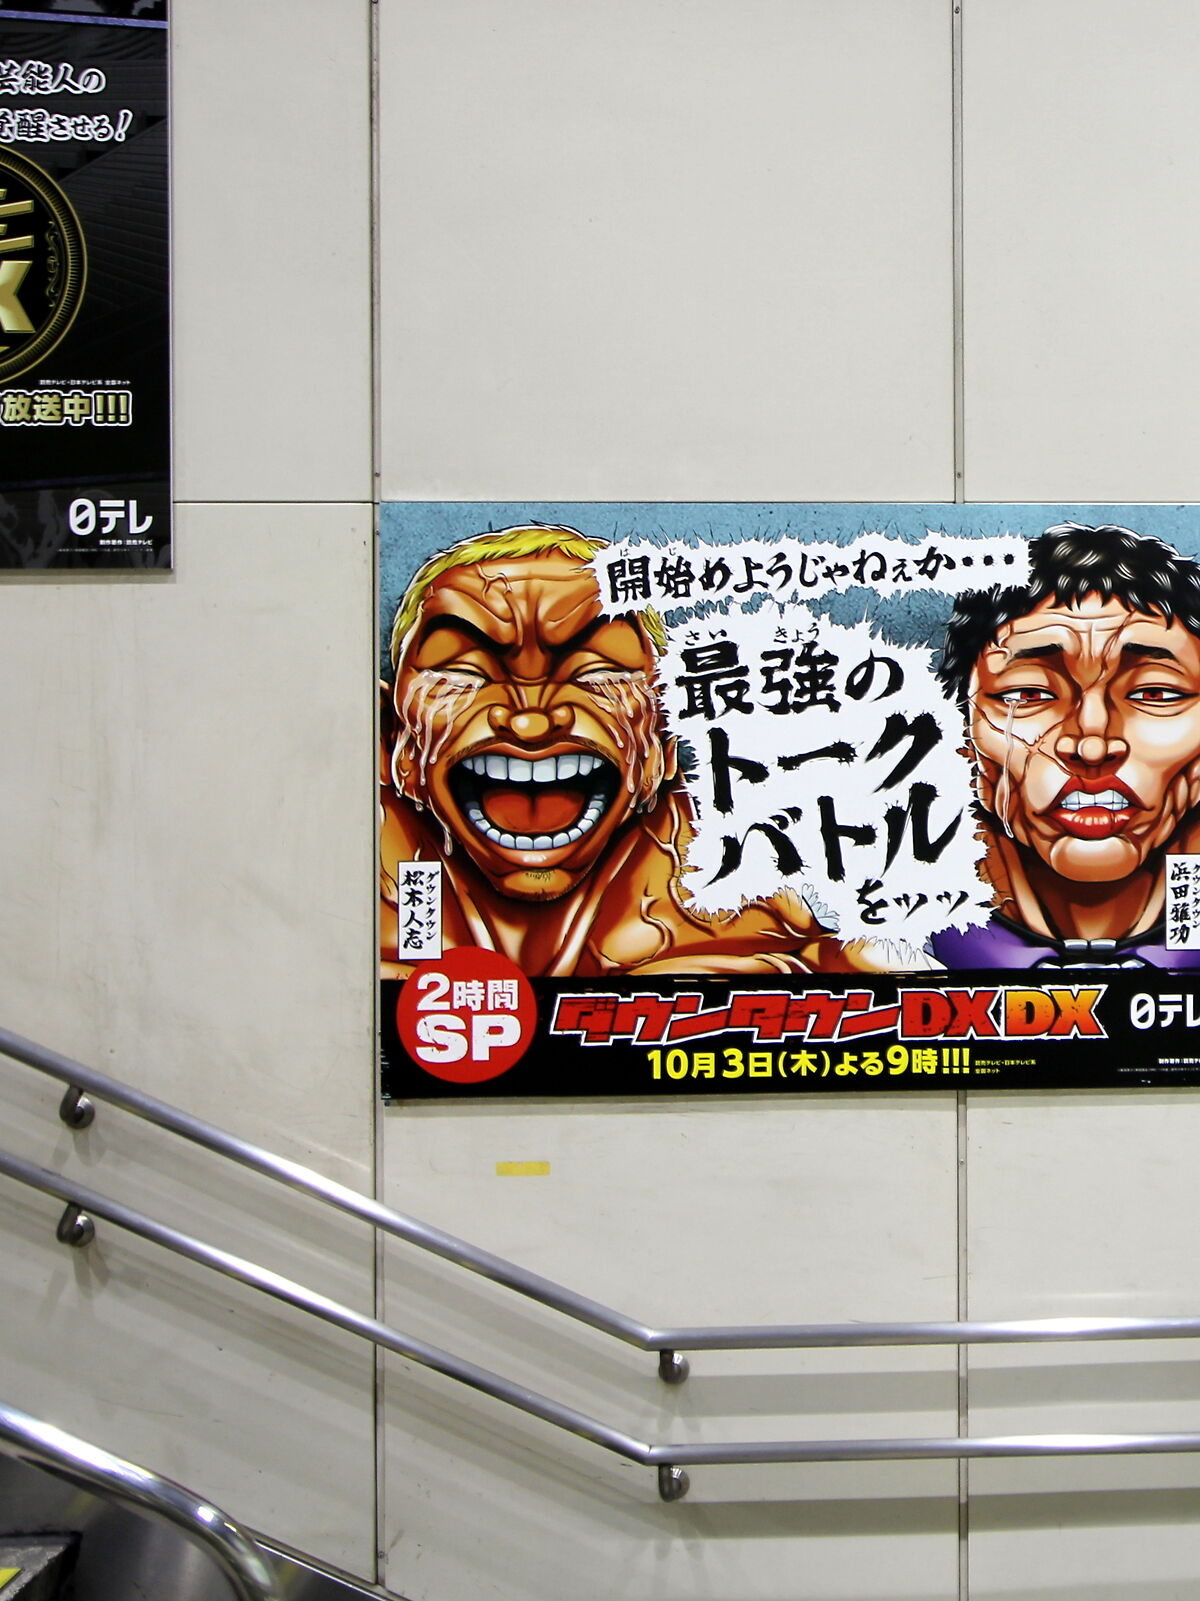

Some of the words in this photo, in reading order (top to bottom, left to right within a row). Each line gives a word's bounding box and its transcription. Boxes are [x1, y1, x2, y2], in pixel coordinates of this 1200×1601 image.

[675, 640, 905, 721] 最強の
[706, 711, 943, 814] トーク
[702, 782, 964, 888] バトル
[1170, 862, 1191, 944] 浜田雅功
[416, 973, 518, 1012] 2時間
[416, 1015, 521, 1063] SP
